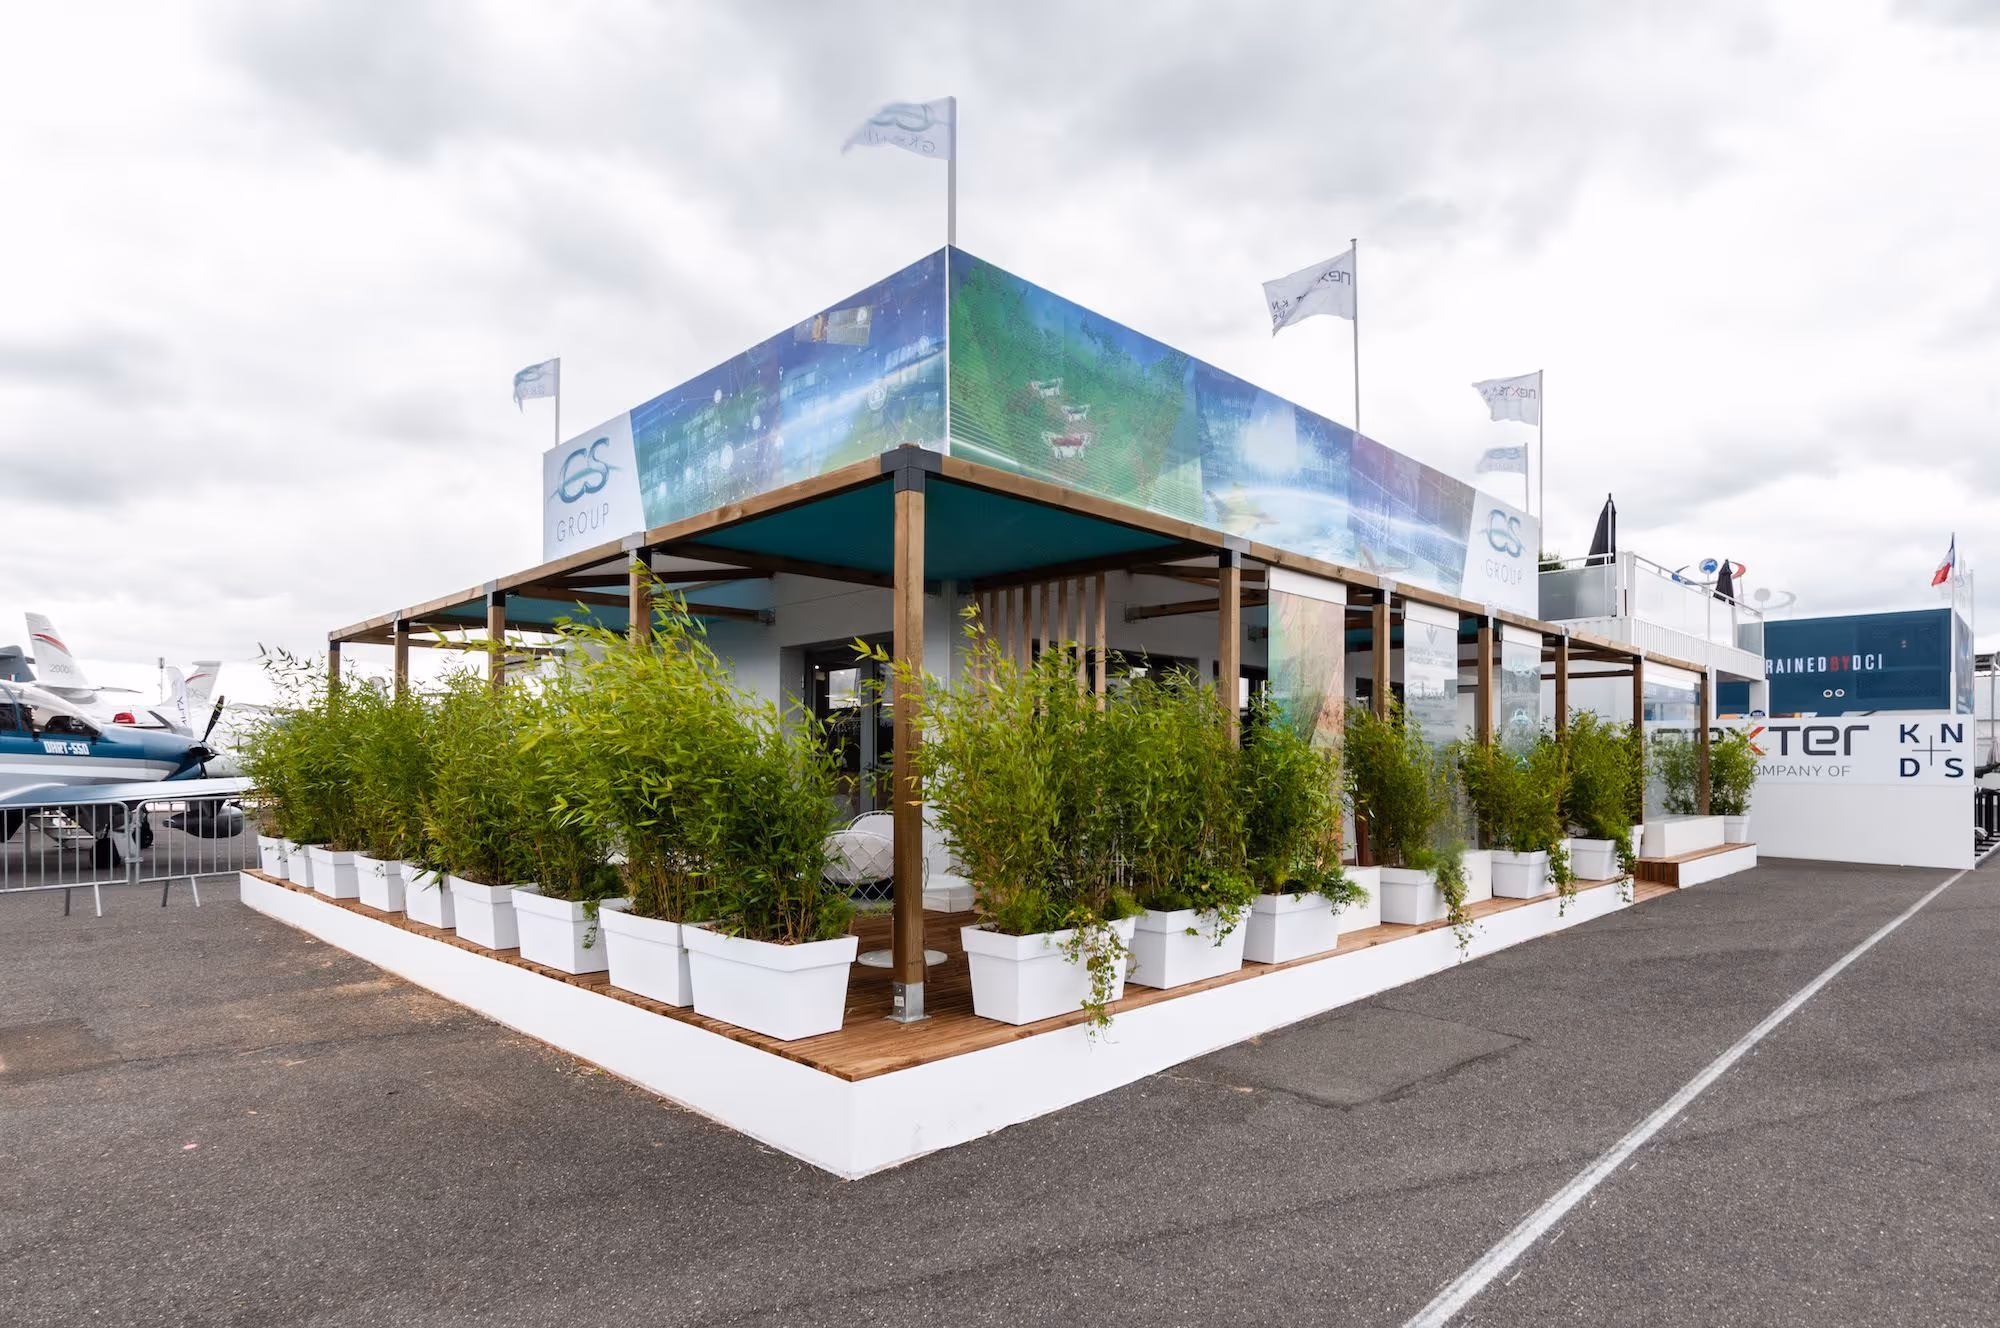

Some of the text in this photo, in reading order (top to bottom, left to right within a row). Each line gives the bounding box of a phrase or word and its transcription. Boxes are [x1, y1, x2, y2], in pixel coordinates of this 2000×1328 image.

[556, 502, 609, 542] GROUP
[1486, 559, 1522, 585] GROUP
[1750, 765, 1850, 777] OMPANY OF
